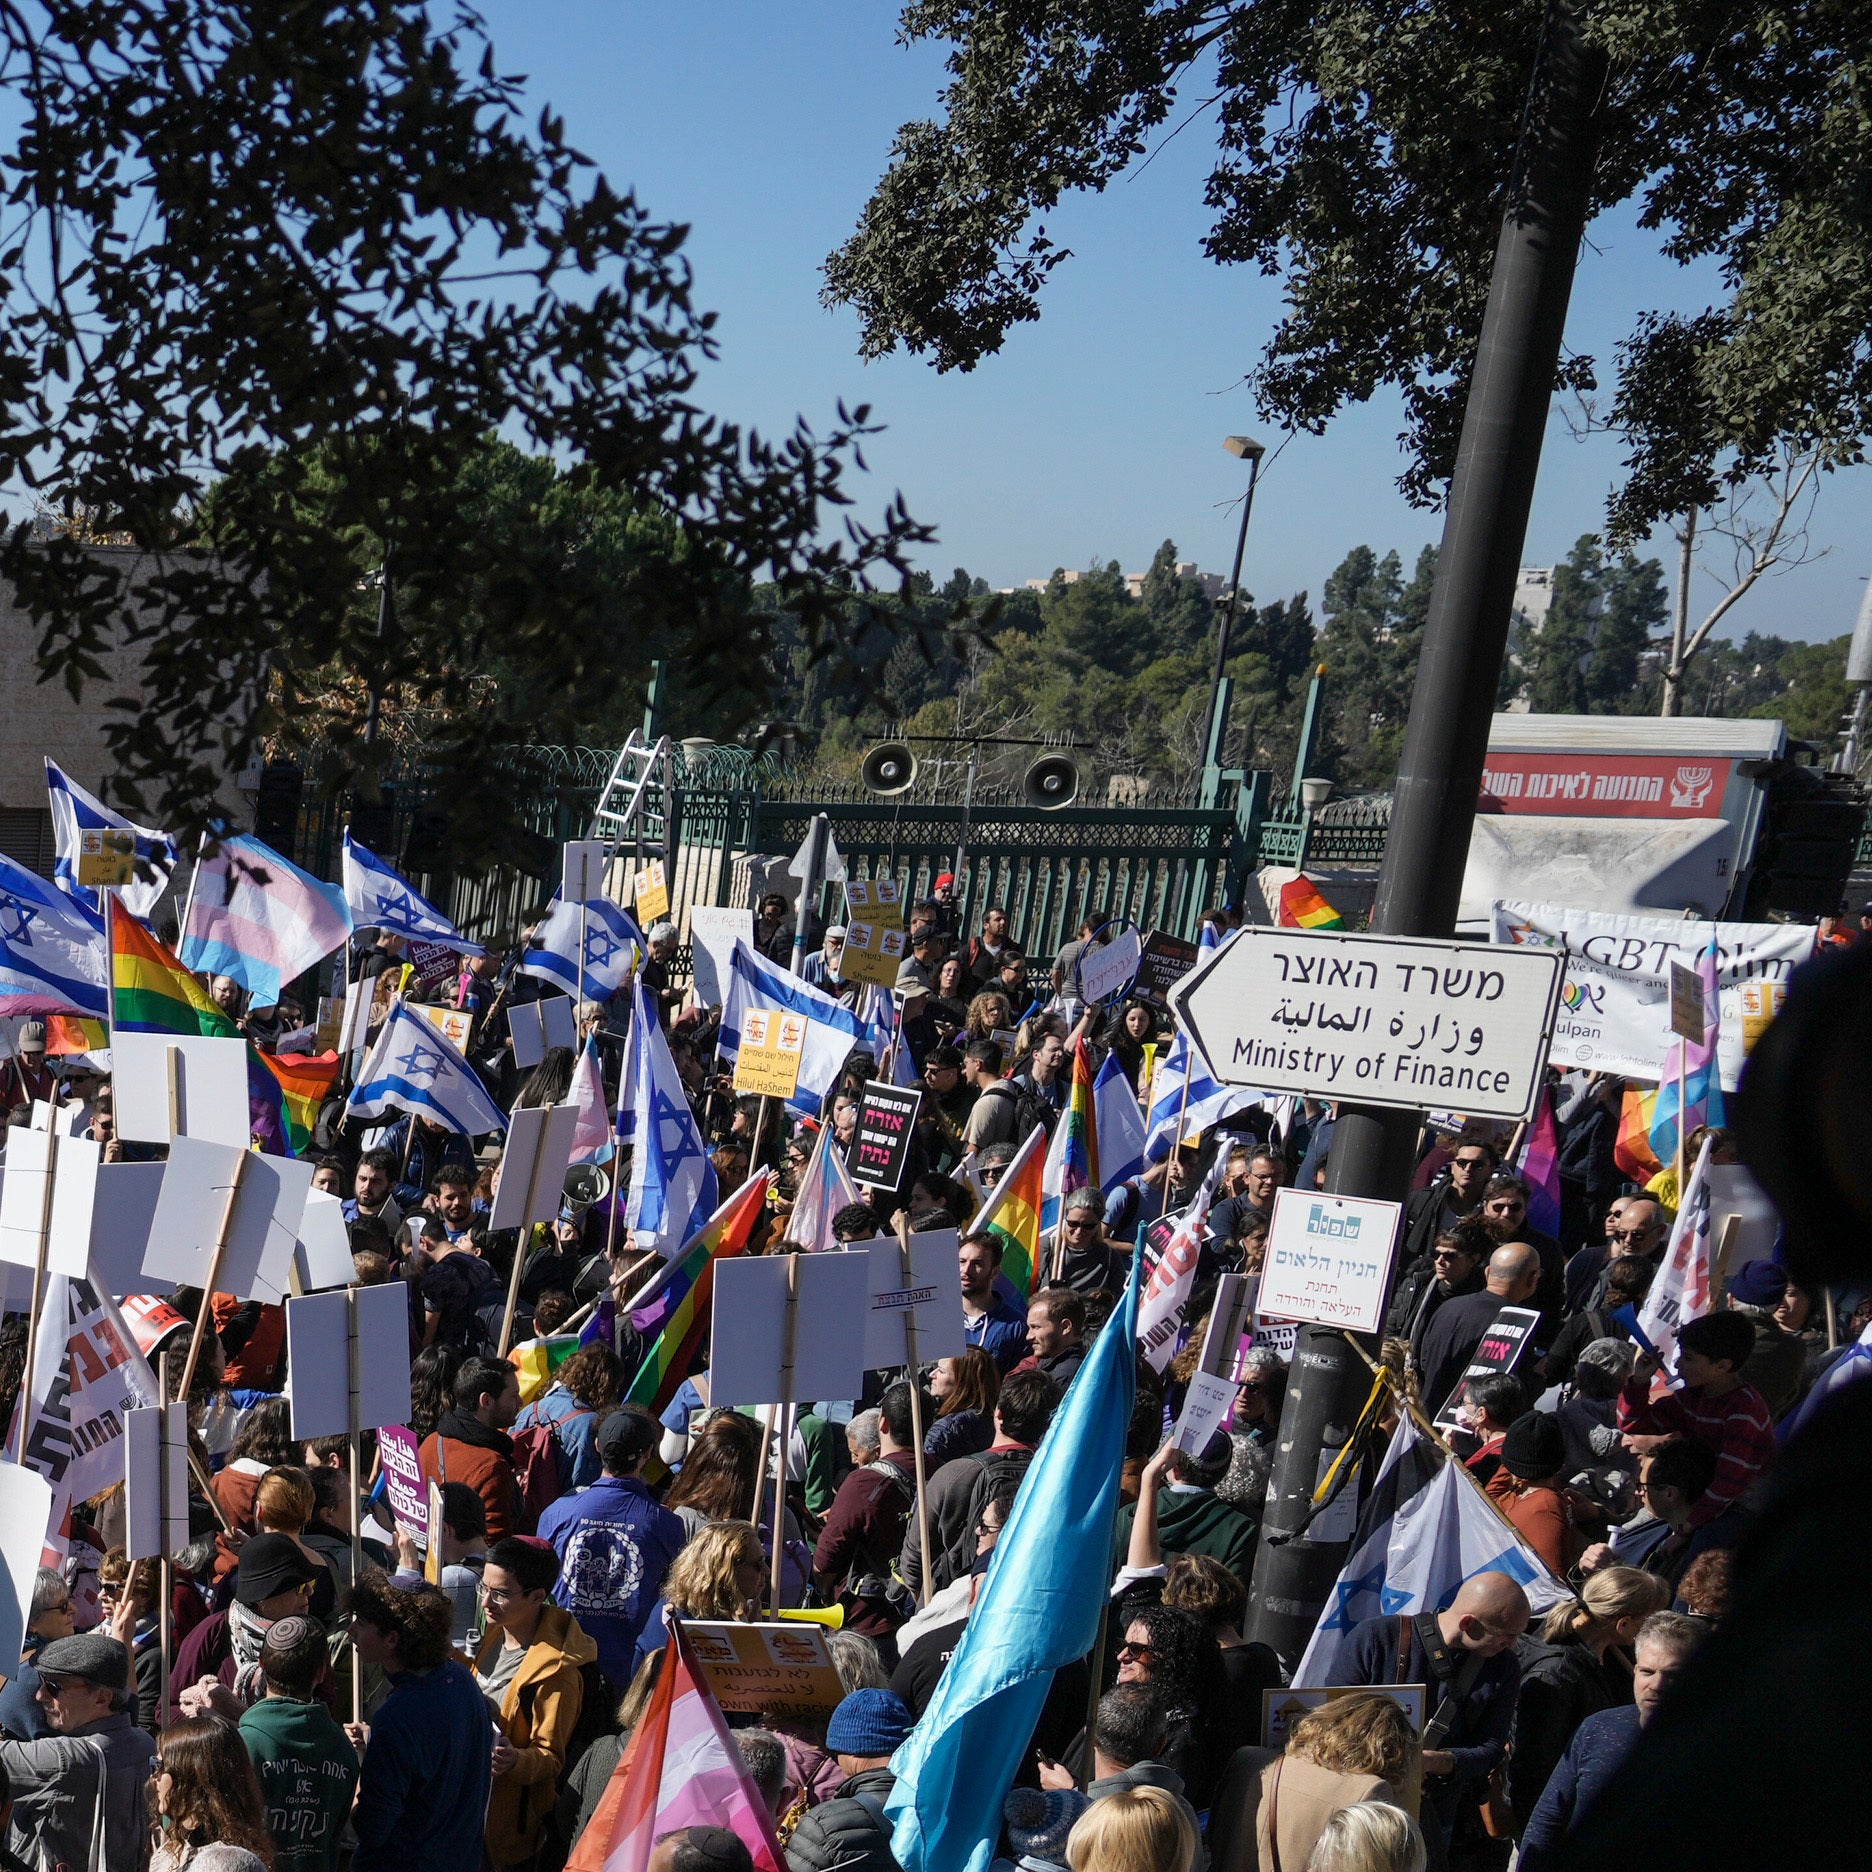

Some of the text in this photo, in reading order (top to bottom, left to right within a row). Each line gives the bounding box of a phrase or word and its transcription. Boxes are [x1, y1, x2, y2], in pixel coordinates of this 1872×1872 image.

[1524, 771, 1664, 801] התנועה לאיכות
[416, 948, 438, 963] הבית
[860, 950, 882, 961] בושה
[1147, 953, 1179, 967] ברשימה
[1559, 930, 1680, 974] LGBT
[421, 965, 444, 980] כולנו
[852, 970, 883, 984] Shame
[1273, 953, 1506, 1001] משרד האוצר
[1605, 968, 1640, 986] queer
[1270, 996, 1484, 1056] وزارة المالية
[744, 1047, 794, 1063] חילול שם שמיים
[1232, 1038, 1511, 1094] Ministry of Finance
[736, 1077, 792, 1096] Hilul HaShem
[859, 1143, 892, 1166] נתין
[1307, 1203, 1363, 1240] שפיר
[1276, 1247, 1377, 1279] חניון הלאום
[1305, 1280, 1338, 1294] תחנת
[1274, 1293, 1361, 1317] העלאה והורדה
[383, 1451, 419, 1477] זה הבית
[389, 1490, 428, 1519] של כולנו
[712, 1664, 811, 1680] לא לגזענות
[752, 1698, 794, 1714] with
